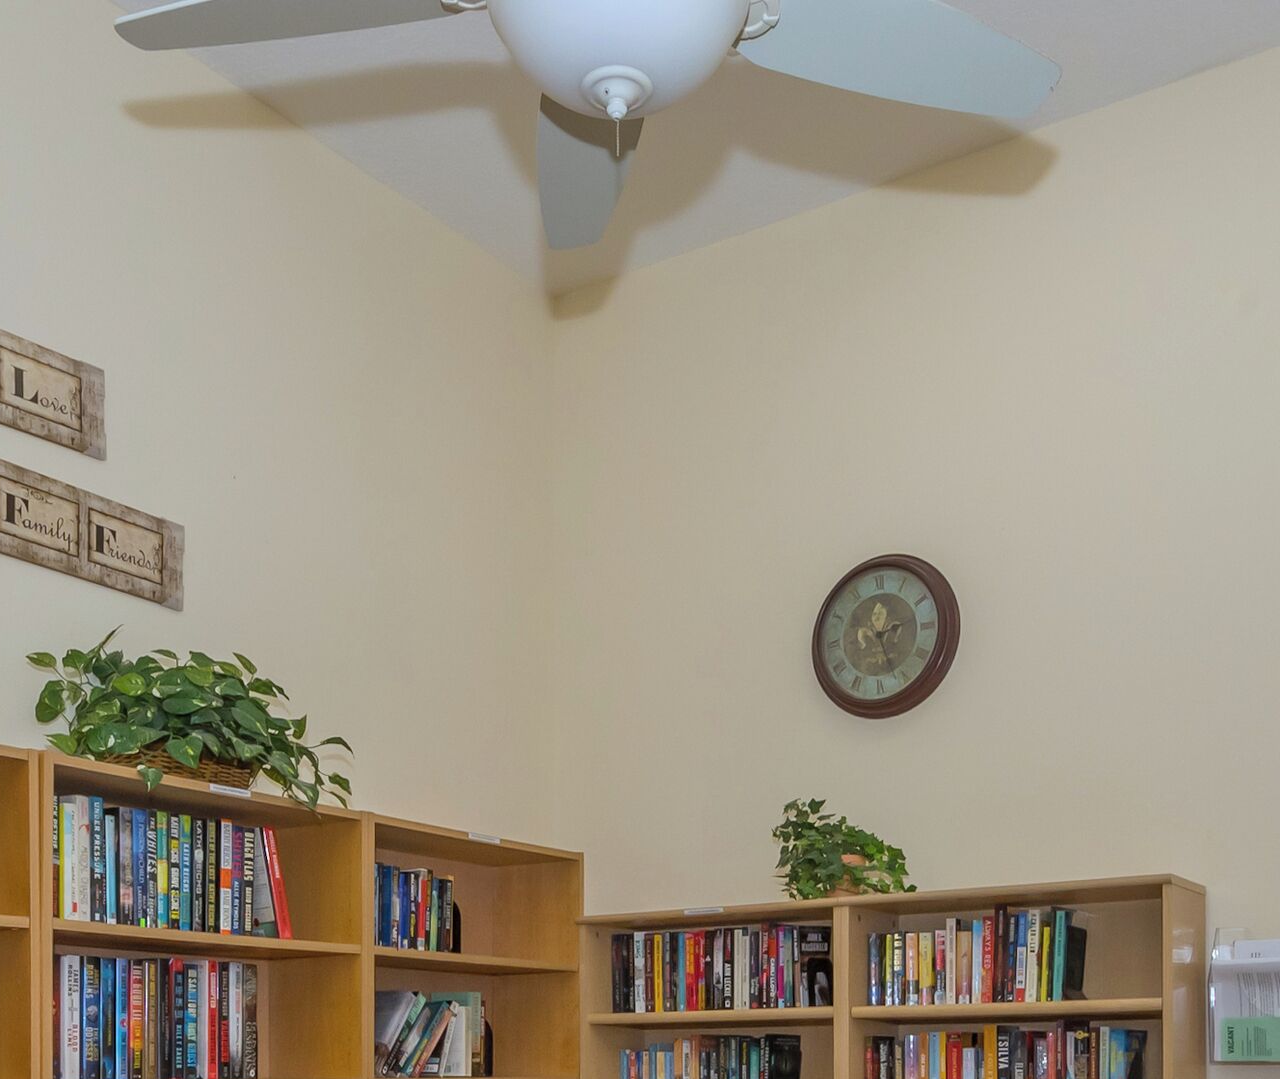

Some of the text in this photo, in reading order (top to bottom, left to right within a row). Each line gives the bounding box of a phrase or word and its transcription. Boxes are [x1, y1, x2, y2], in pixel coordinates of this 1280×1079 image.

[11, 365, 69, 416] Love
[3, 492, 75, 553] Family
[95, 525, 155, 569] Friends
[147, 831, 157, 874] WHITES
[984, 920, 992, 951] ALWAYS
[999, 1041, 1009, 1069] SILVA
